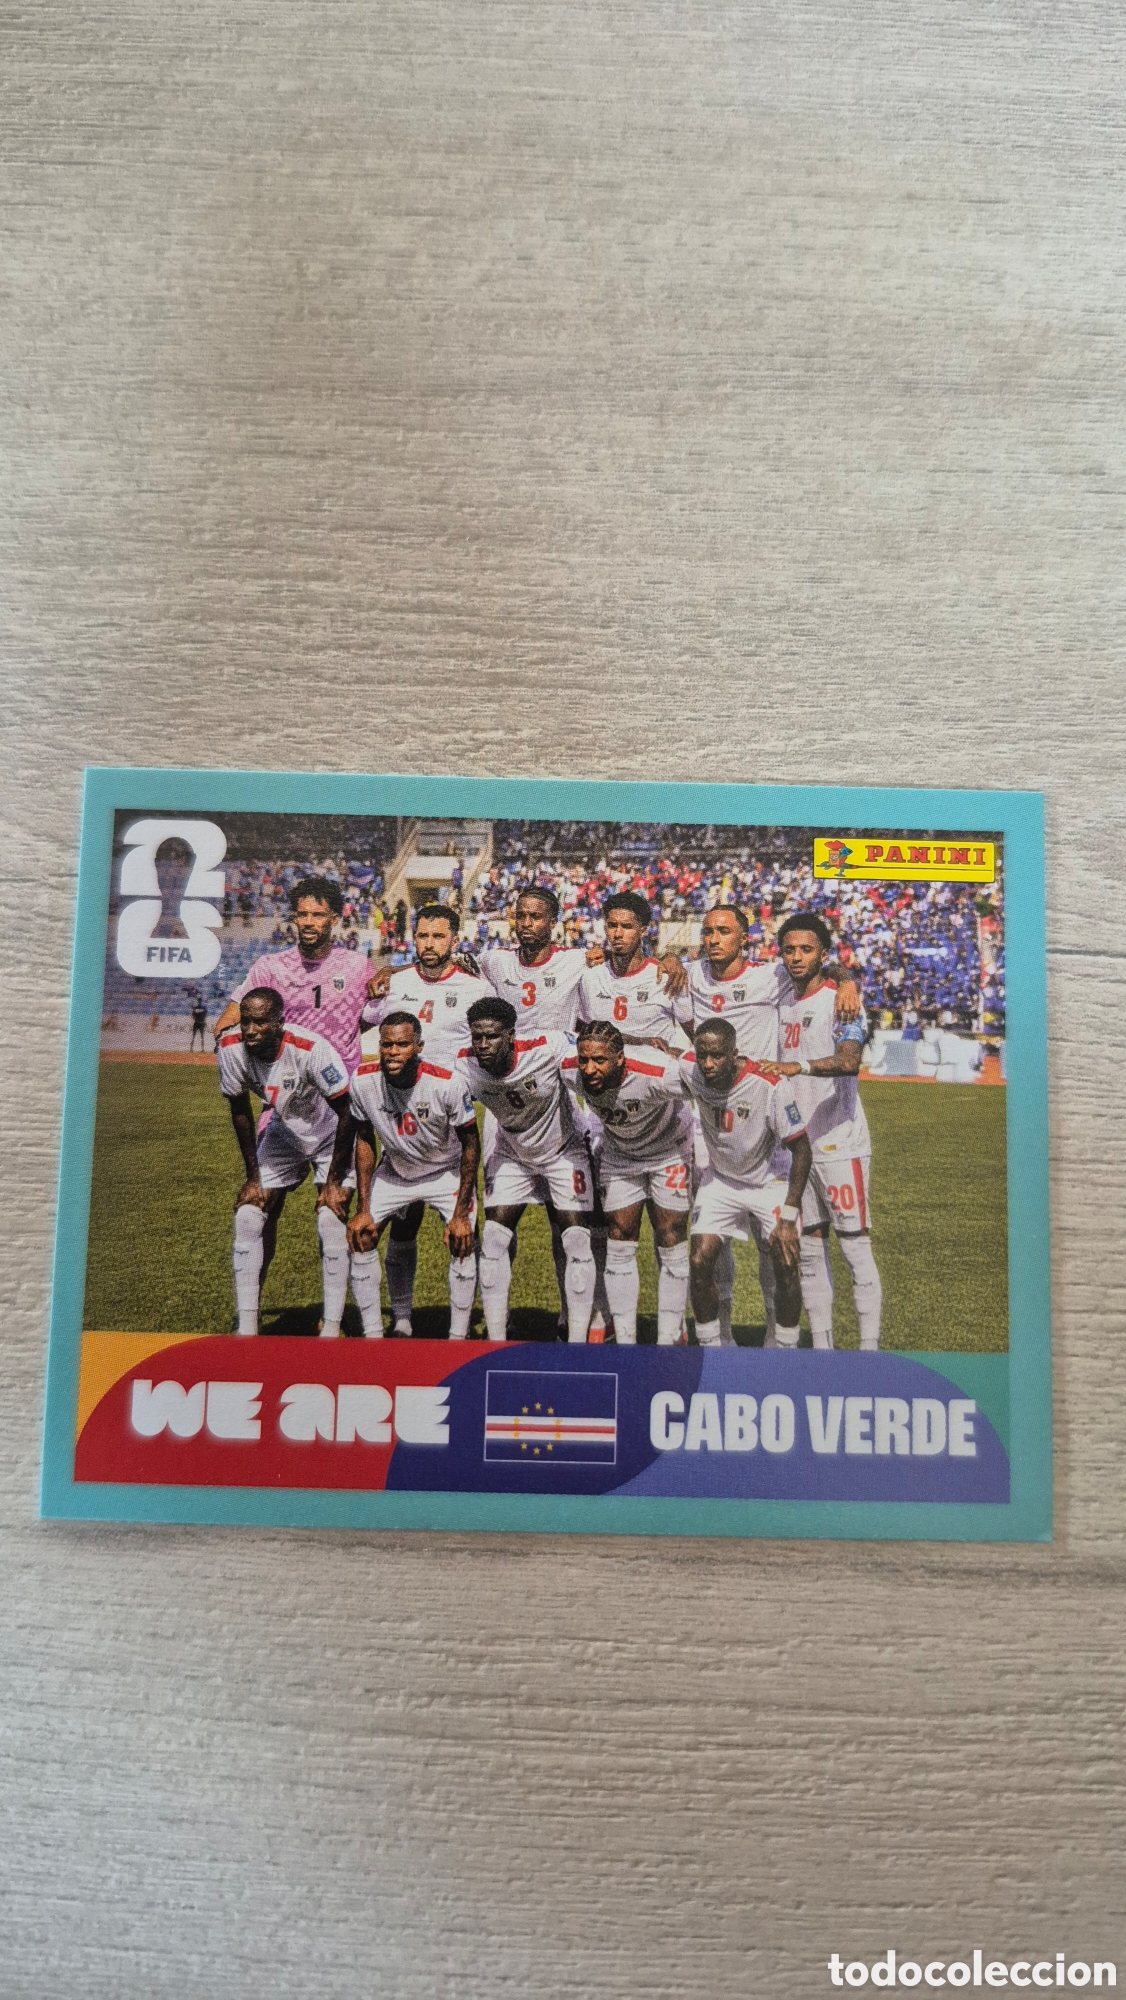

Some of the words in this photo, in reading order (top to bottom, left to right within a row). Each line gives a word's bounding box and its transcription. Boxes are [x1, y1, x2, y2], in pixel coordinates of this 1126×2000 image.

[865, 845, 986, 865] PANINI
[146, 946, 193, 963] FIFA
[312, 985, 321, 1009] 1
[521, 981, 537, 1006] 3
[417, 1000, 435, 1023] 4
[613, 996, 628, 1021] 6
[784, 1023, 800, 1048] 20
[266, 1085, 279, 1107] 7
[506, 1090, 525, 1108] 8
[393, 1111, 417, 1136] 16
[600, 1107, 632, 1126] 22
[712, 1106, 734, 1133] 10
[572, 1170, 586, 1195] 8
[828, 1184, 855, 1211] 20
[131, 1379, 263, 1440] WE
[649, 1391, 795, 1452] CABO
[805, 1396, 976, 1456] VERDE
